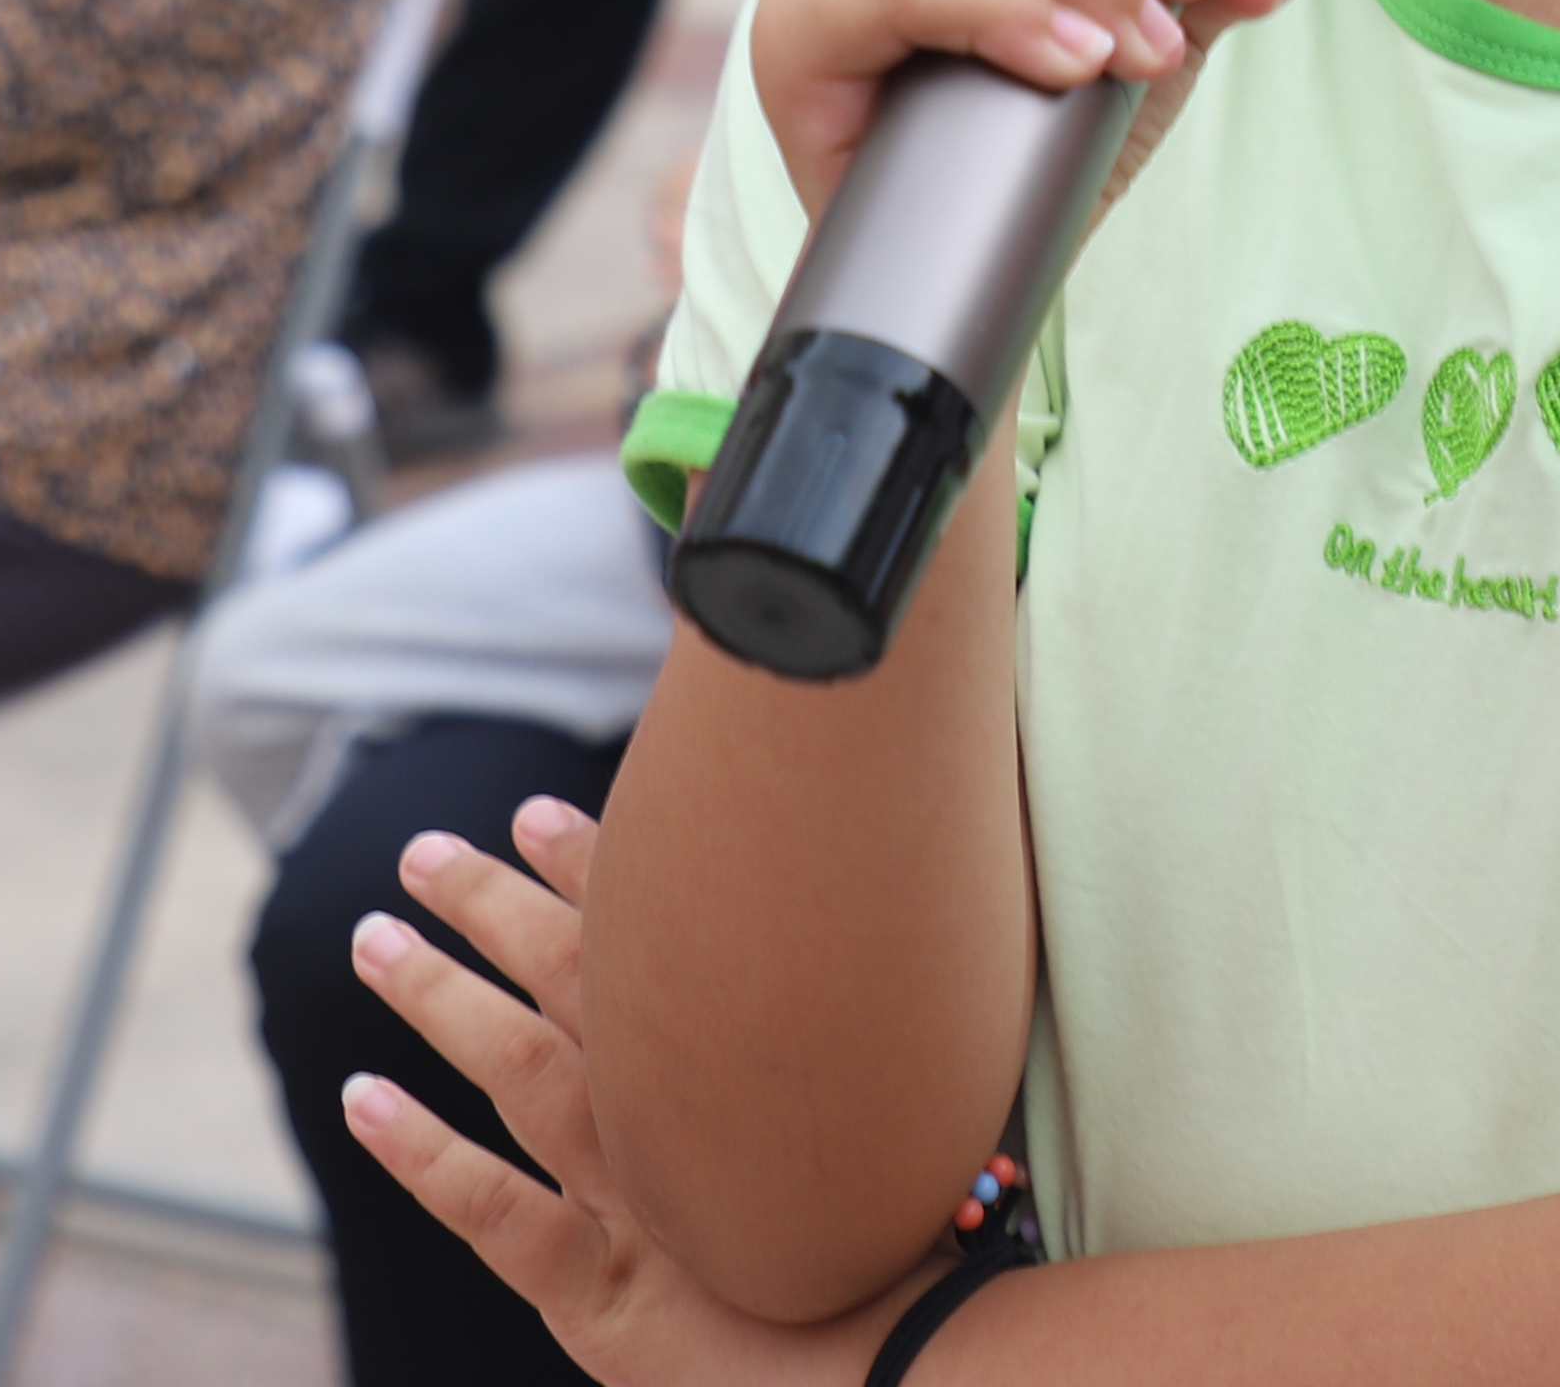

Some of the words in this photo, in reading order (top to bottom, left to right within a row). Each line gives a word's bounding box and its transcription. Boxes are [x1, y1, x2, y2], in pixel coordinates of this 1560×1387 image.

[1323, 521, 1377, 580] On
[1379, 545, 1447, 601] the
[1448, 555, 1558, 621] heart
